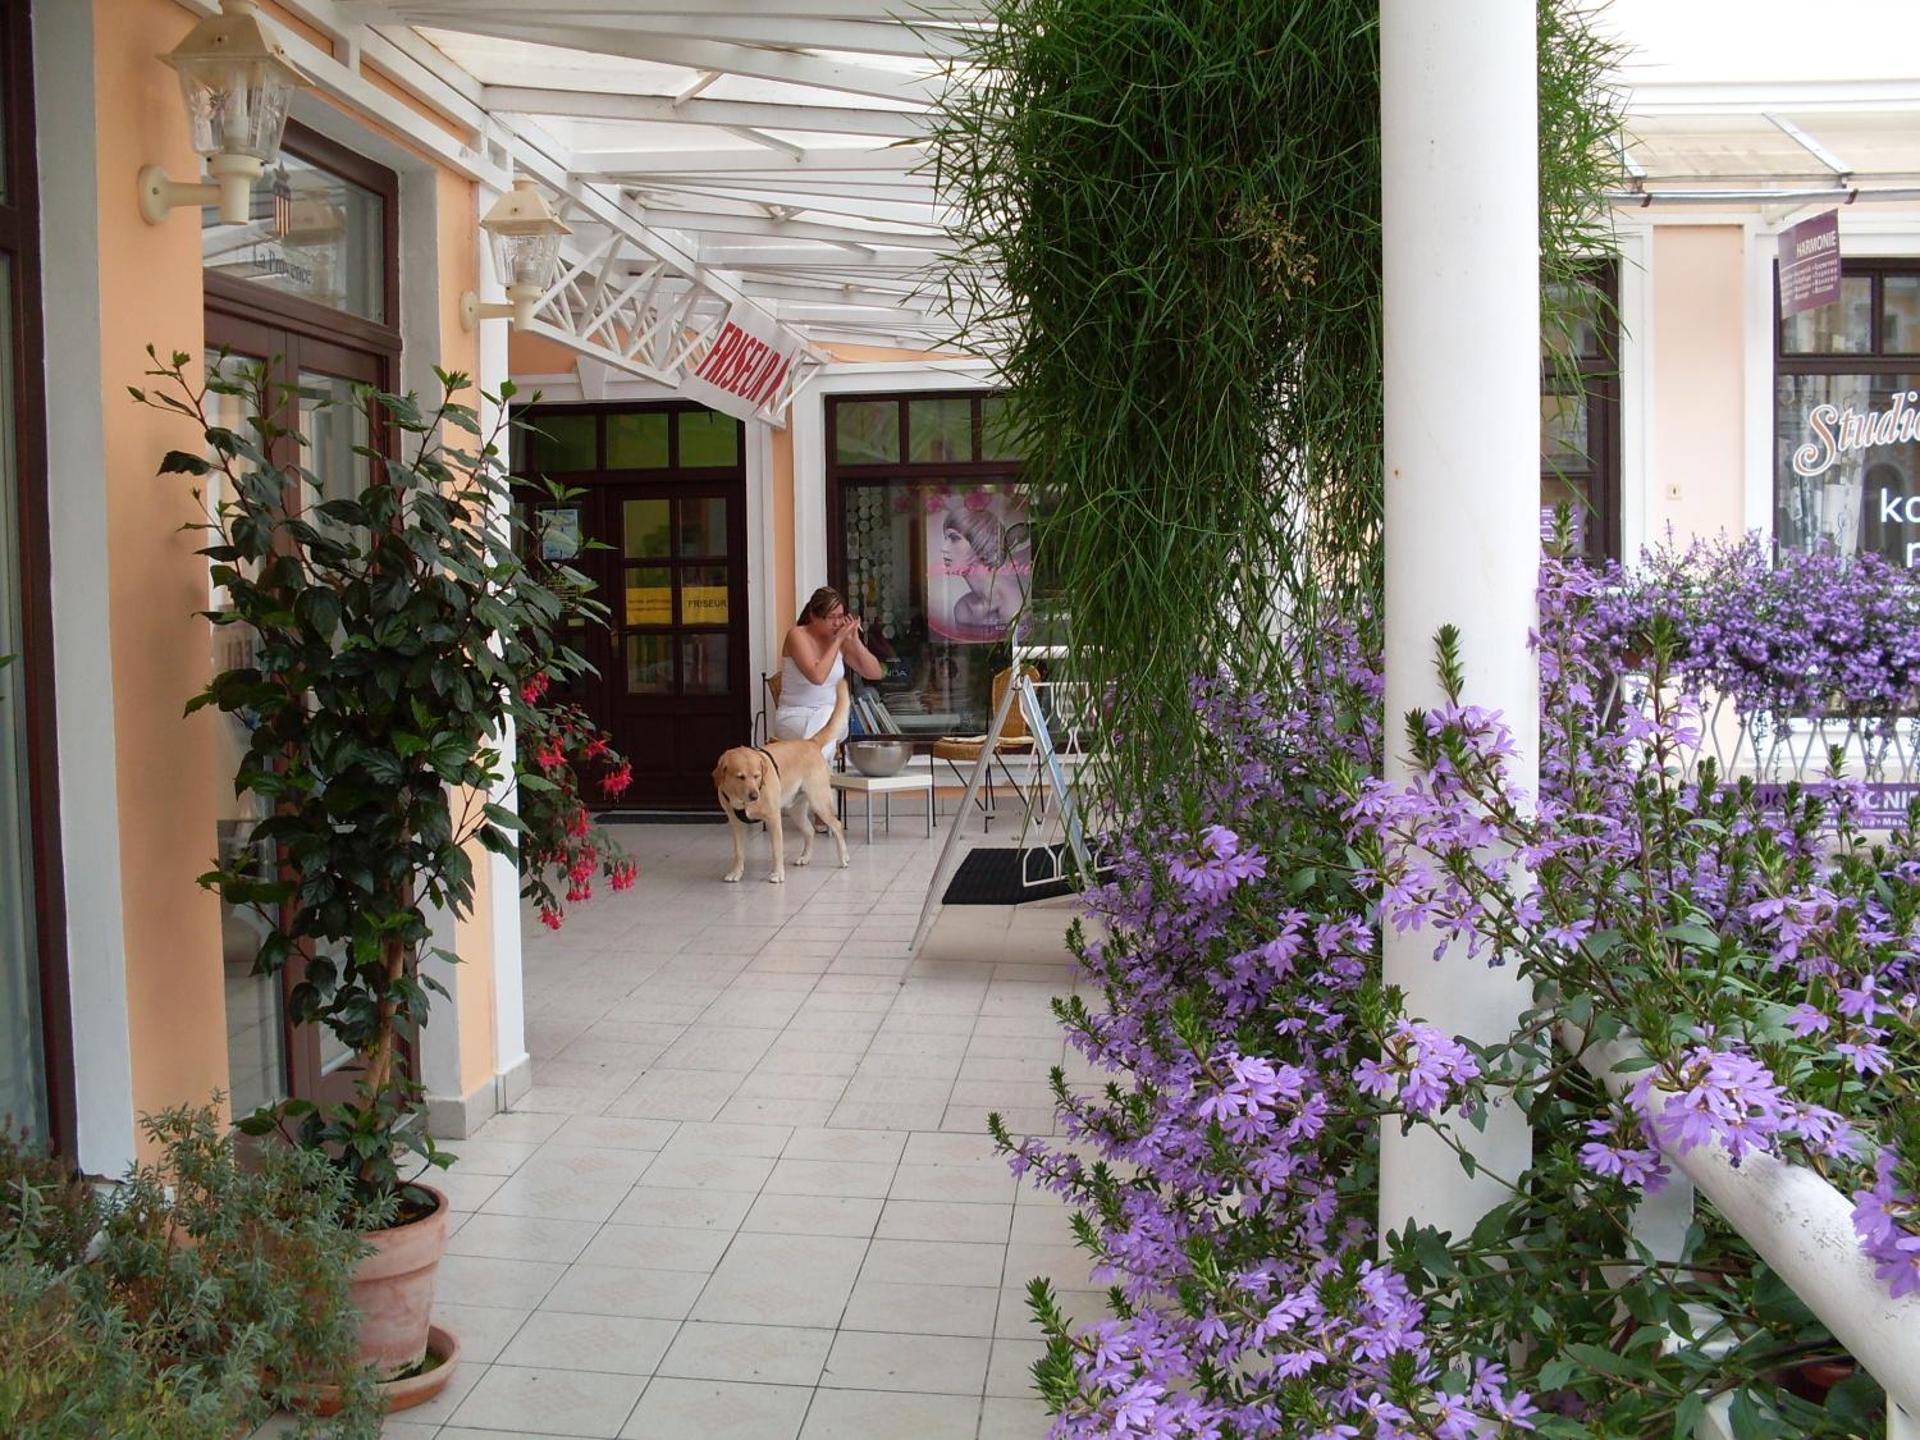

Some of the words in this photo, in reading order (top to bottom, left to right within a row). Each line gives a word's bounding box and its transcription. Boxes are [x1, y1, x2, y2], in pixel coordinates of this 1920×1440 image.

[1796, 231, 1837, 258] HARMONIE
[694, 320, 781, 403] FRISEUR
[688, 599, 728, 608] FRISEUR
